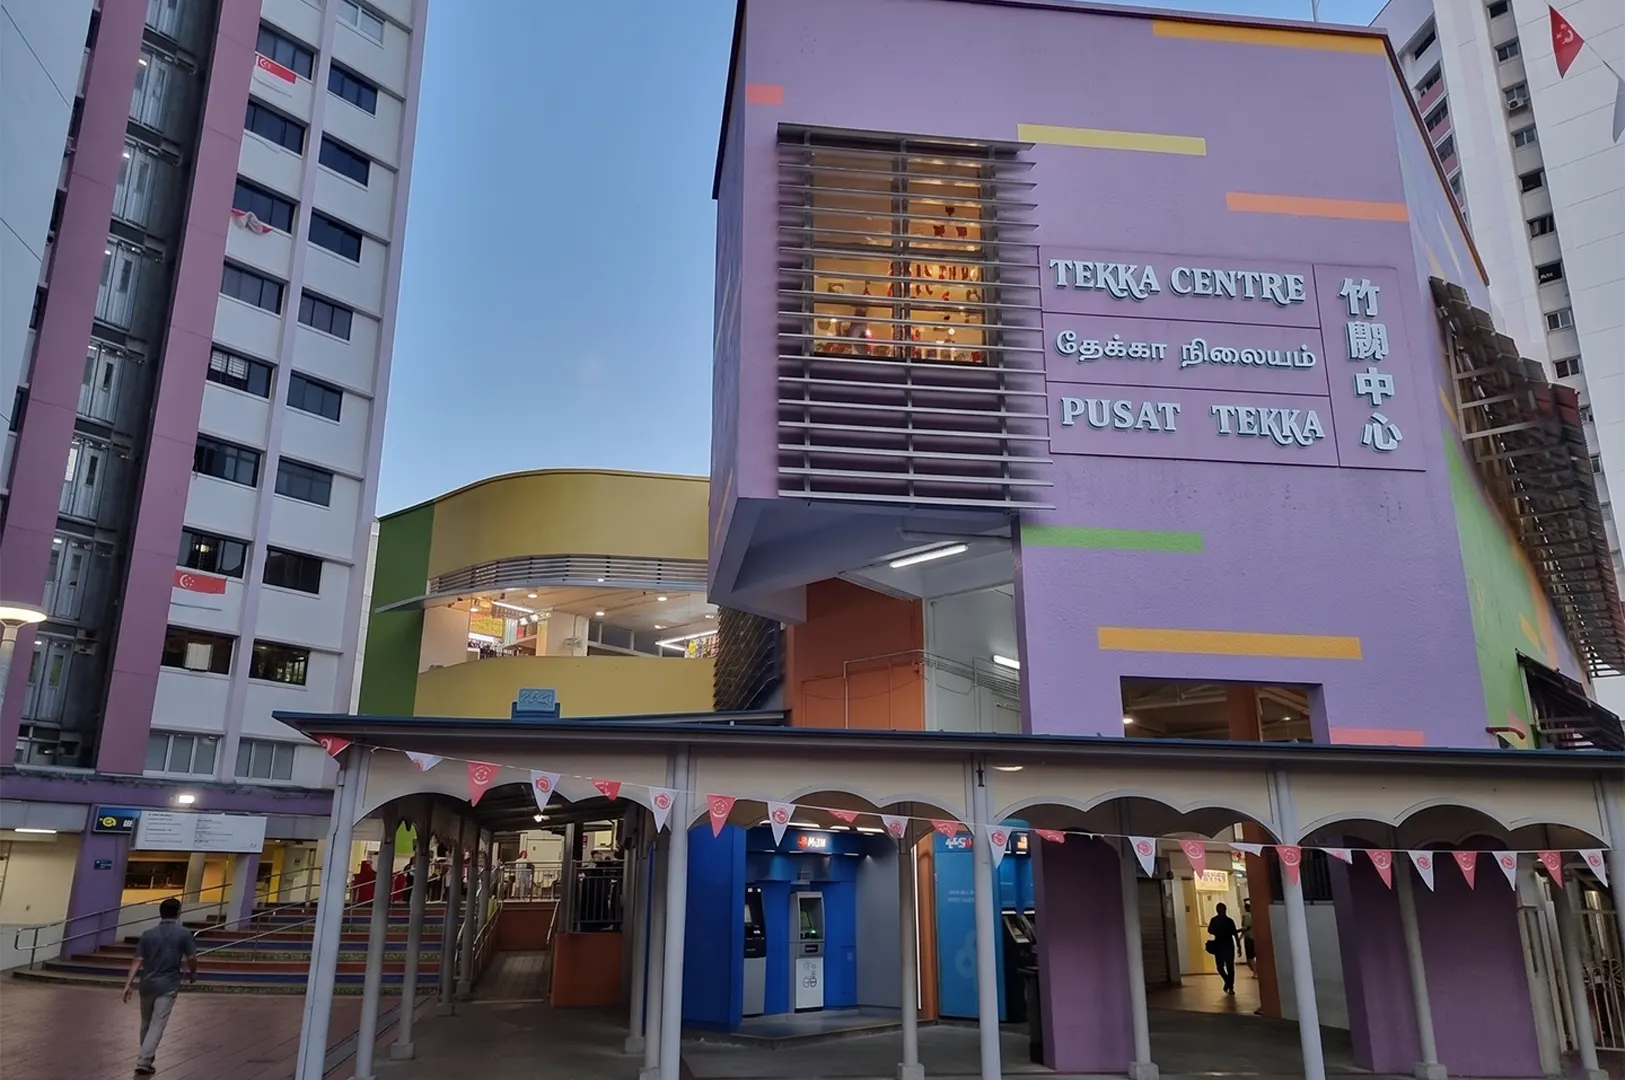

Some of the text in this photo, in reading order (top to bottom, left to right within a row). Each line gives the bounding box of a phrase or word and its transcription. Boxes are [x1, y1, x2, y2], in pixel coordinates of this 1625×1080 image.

[1049, 259, 1306, 306] TEKKA CENTRE
[1056, 330, 1317, 368] தேக்கா நிலையம்
[1060, 396, 1326, 446] PUSAT TEKKA
